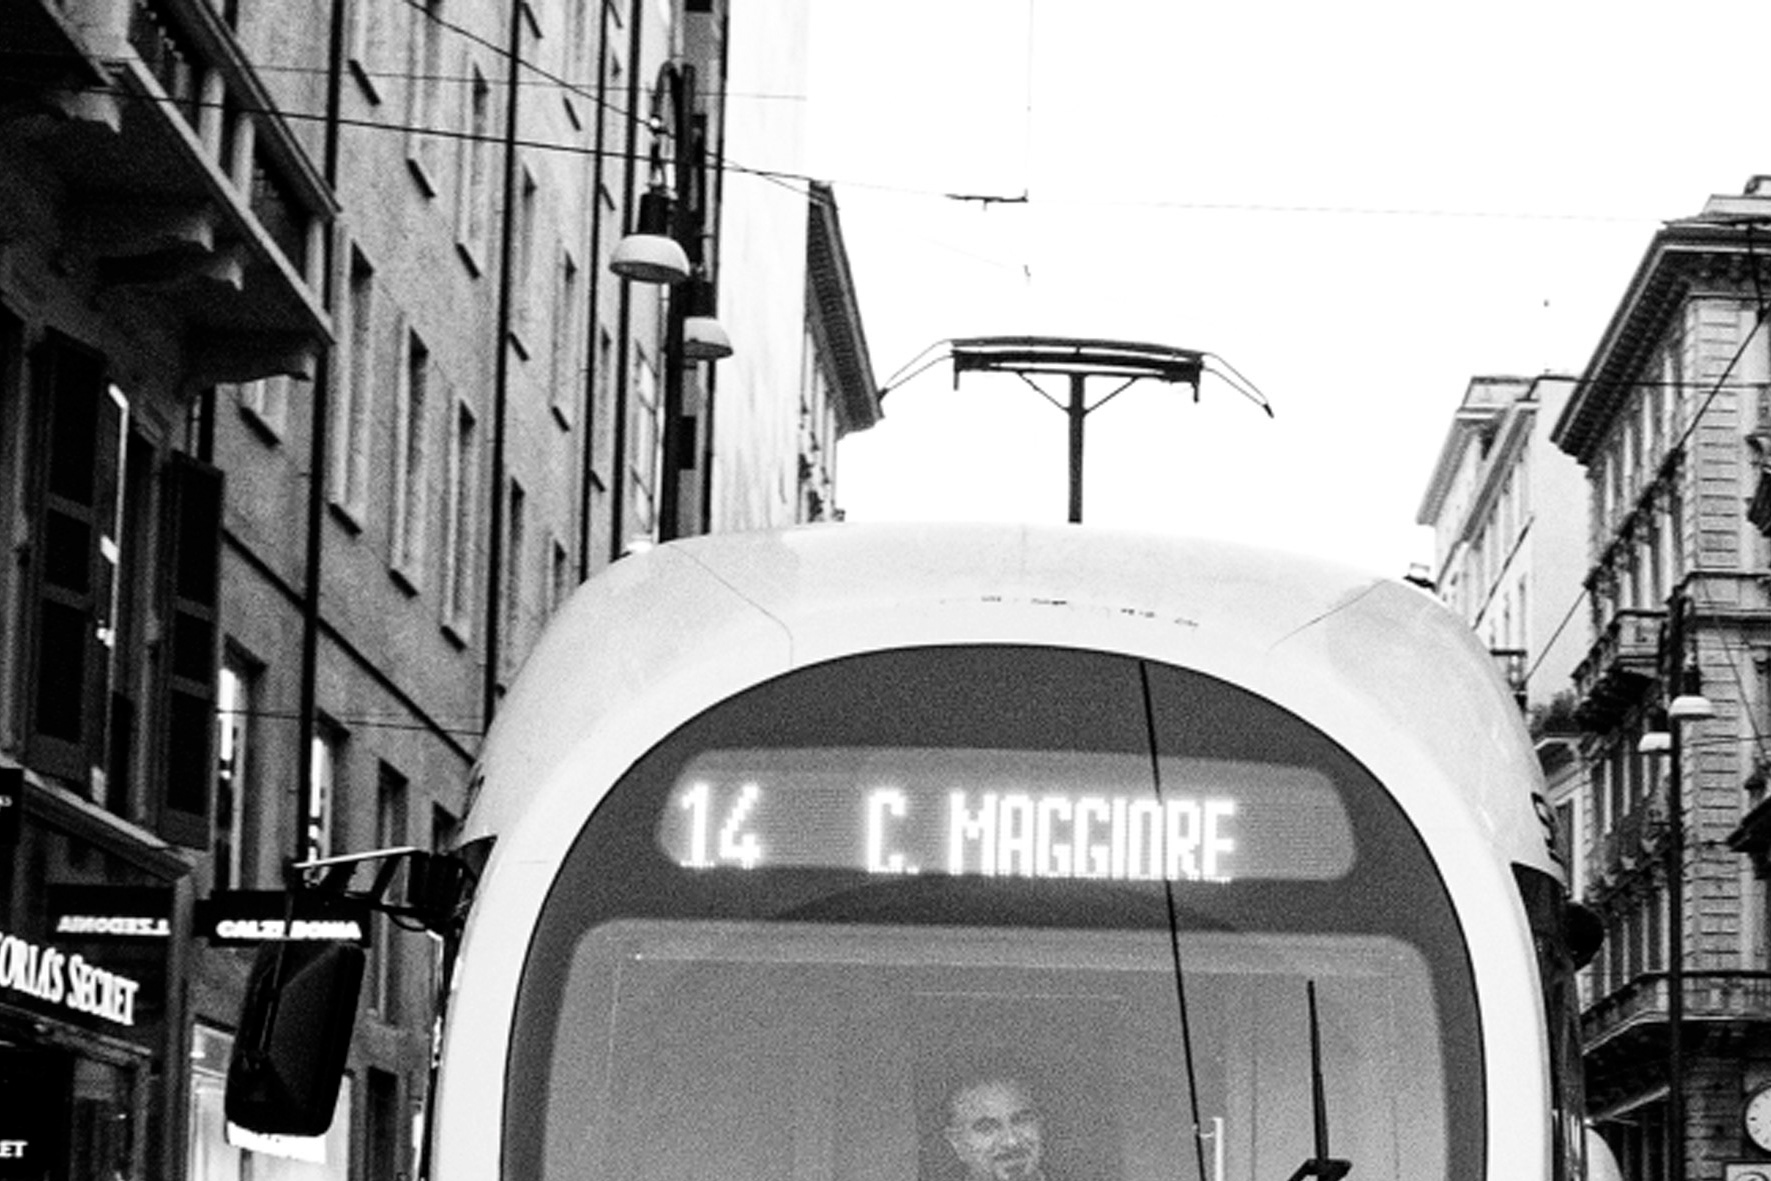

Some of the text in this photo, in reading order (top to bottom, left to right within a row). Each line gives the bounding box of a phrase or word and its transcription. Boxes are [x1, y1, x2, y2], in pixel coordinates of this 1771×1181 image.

[681, 784, 761, 868] 14
[948, 792, 1234, 882] MAGGIORE
[0, 931, 140, 1026] ORIA'S SECRET
